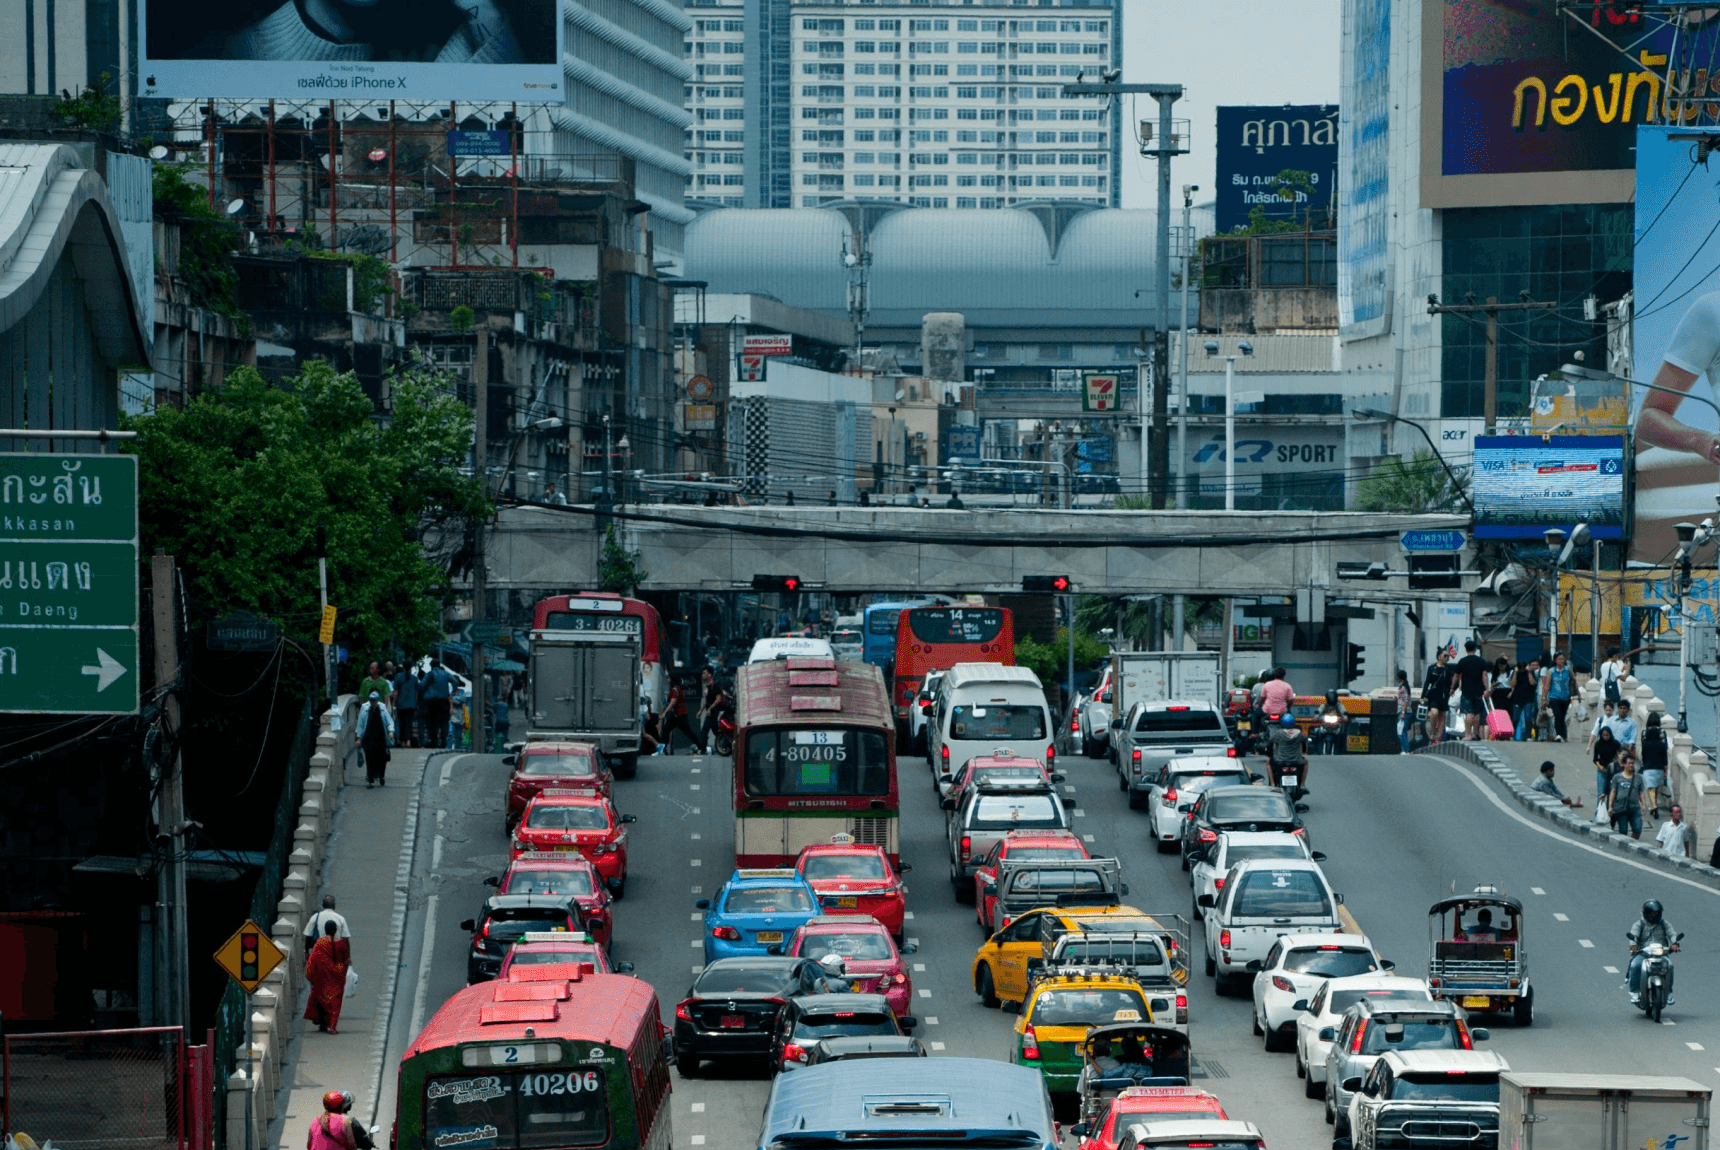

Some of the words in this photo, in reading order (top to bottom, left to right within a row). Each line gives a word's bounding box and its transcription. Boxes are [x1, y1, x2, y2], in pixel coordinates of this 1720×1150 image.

[351, 76, 395, 88] iPhone
[397, 77, 407, 88] X
[1241, 111, 1339, 154] ศุภาลั
[1311, 173, 1319, 185] 9
[951, 433, 976, 447] PR
[1443, 429, 1467, 440] acer
[1277, 444, 1337, 463] SPORT
[1481, 460, 1505, 471] VISA
[0, 516, 76, 531] kkasan
[20, 602, 79, 620] Daeng
[592, 601, 600, 609] 2
[949, 609, 964, 620] 14
[1233, 625, 1272, 641] IGH
[811, 732, 828, 744] 13
[504, 1047, 519, 1063] 2
